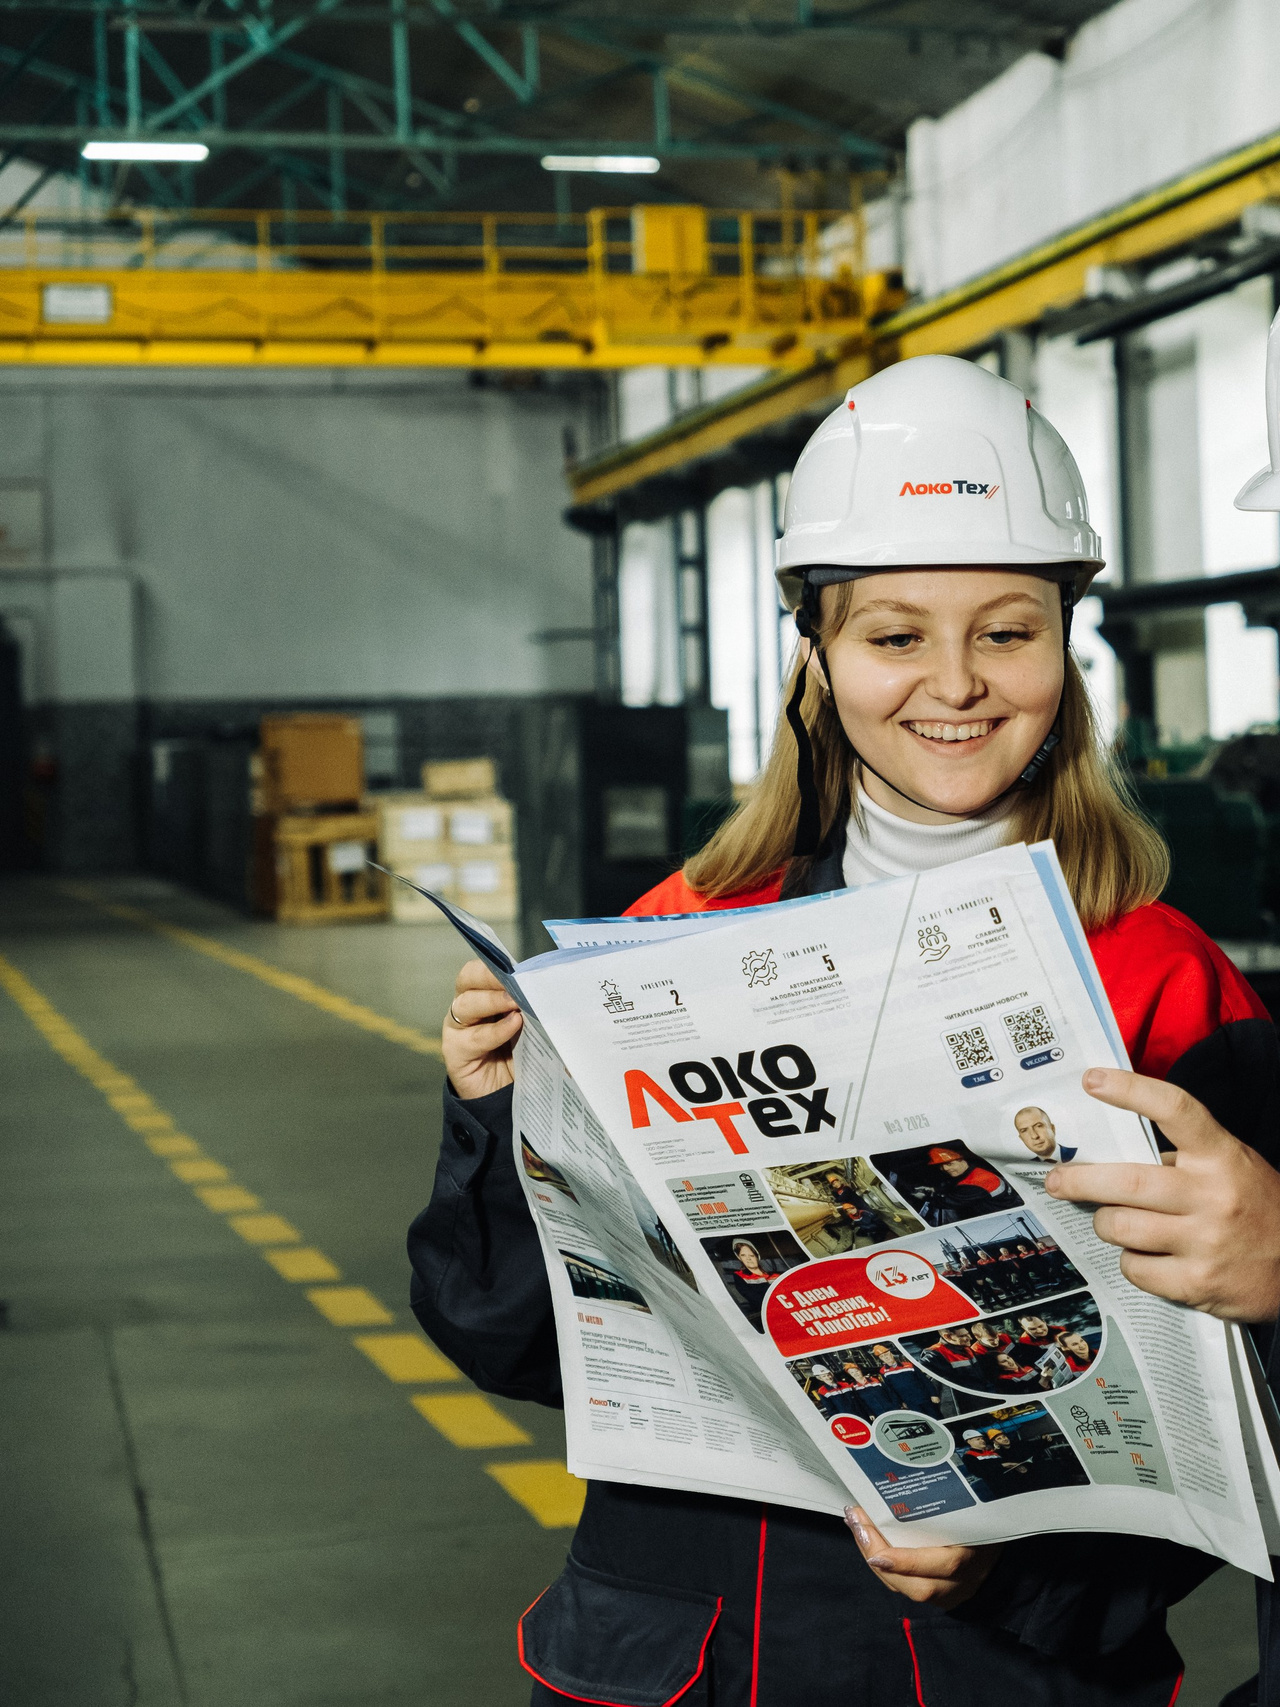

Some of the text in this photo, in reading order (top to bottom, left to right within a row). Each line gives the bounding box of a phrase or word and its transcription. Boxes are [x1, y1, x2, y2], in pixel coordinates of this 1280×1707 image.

[899, 480, 993, 497] ЛокоТех
[989, 907, 1002, 924] 9
[967, 933, 1009, 950] ПУТЬ ВМЕСТЕ
[975, 926, 1006, 940] СЛАВНЫЙ
[783, 950, 799, 959] ТЕМА
[822, 954, 835, 972] 5
[780, 991, 801, 1000] ПОЛЬЗУ
[802, 980, 843, 995] НАДЕЖНОСТИ
[789, 973, 840, 990] АВТОМАТИЗАЦИЯ
[670, 990, 683, 1006] 2
[944, 991, 1028, 1021] ЧИТАЙТЕ НАШИ НОВОСТИ
[613, 1007, 687, 1024] КРАСНОЯРСКИЙ ЛОКОМОТИВ
[1025, 1055, 1048, 1067] VK.COM
[690, 1087, 836, 1155] Тех
[883, 1113, 930, 1135] №3 2025
[877, 1265, 930, 1288] 13 лет
[776, 1284, 839, 1309] С Днем
[790, 1295, 876, 1327] рождения,
[805, 1305, 892, 1337] «ЛокоТех»!
[589, 1397, 621, 1408] ЛокоТех
